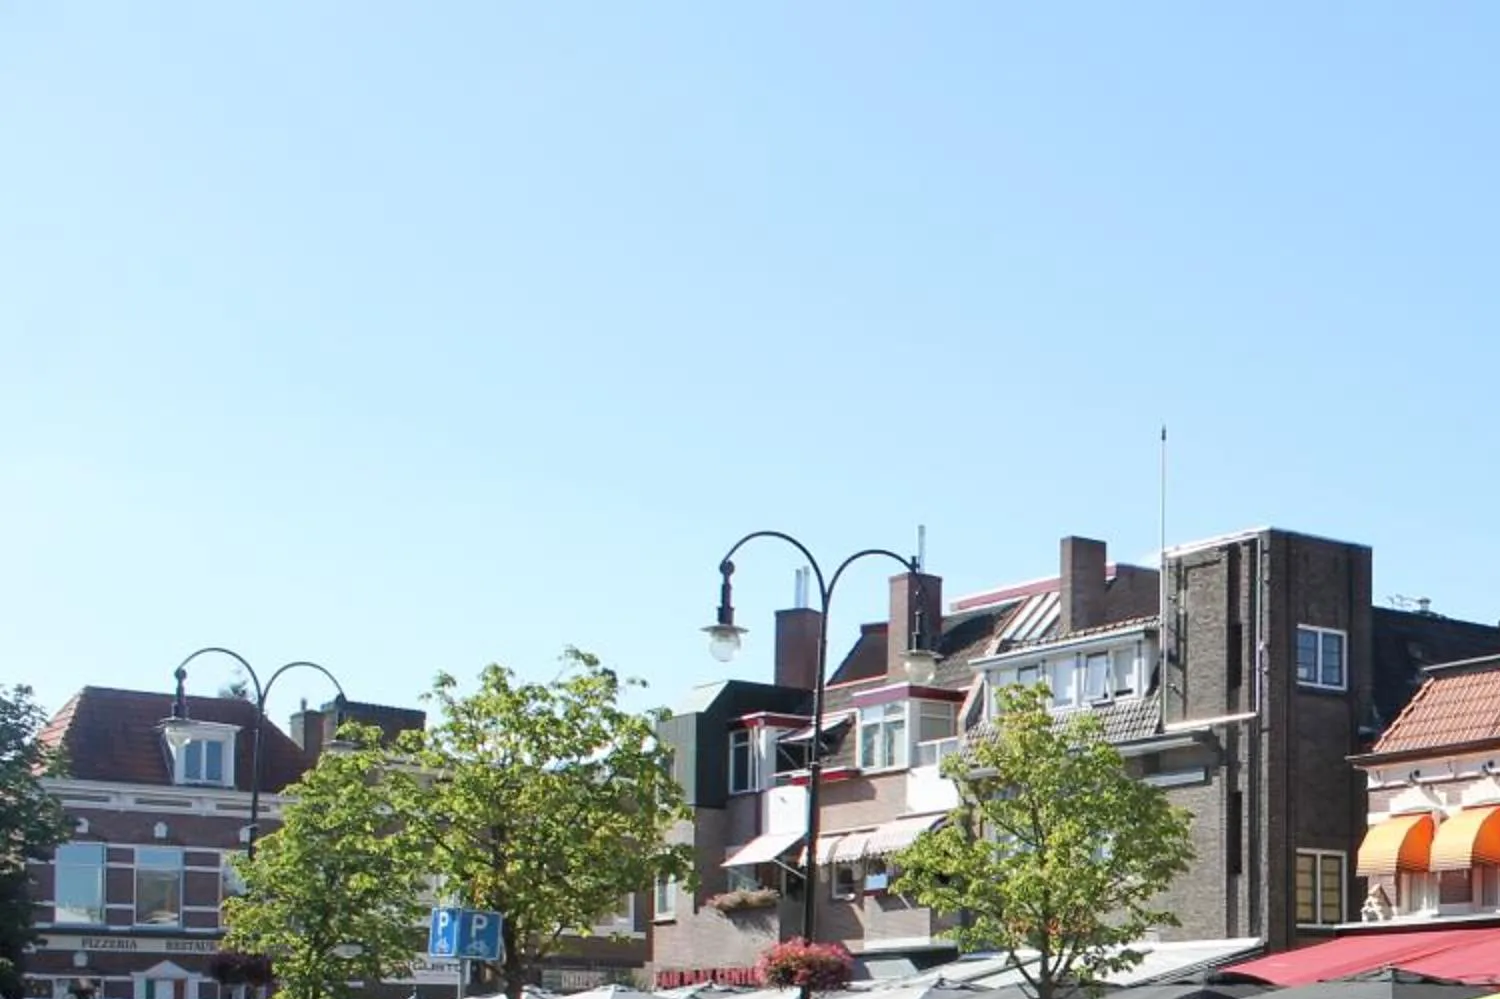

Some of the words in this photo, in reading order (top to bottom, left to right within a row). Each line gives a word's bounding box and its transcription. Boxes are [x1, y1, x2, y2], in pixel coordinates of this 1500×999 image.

[437, 911, 450, 936] P
[471, 914, 488, 938] P
[81, 937, 137, 949] PIZZERIA
